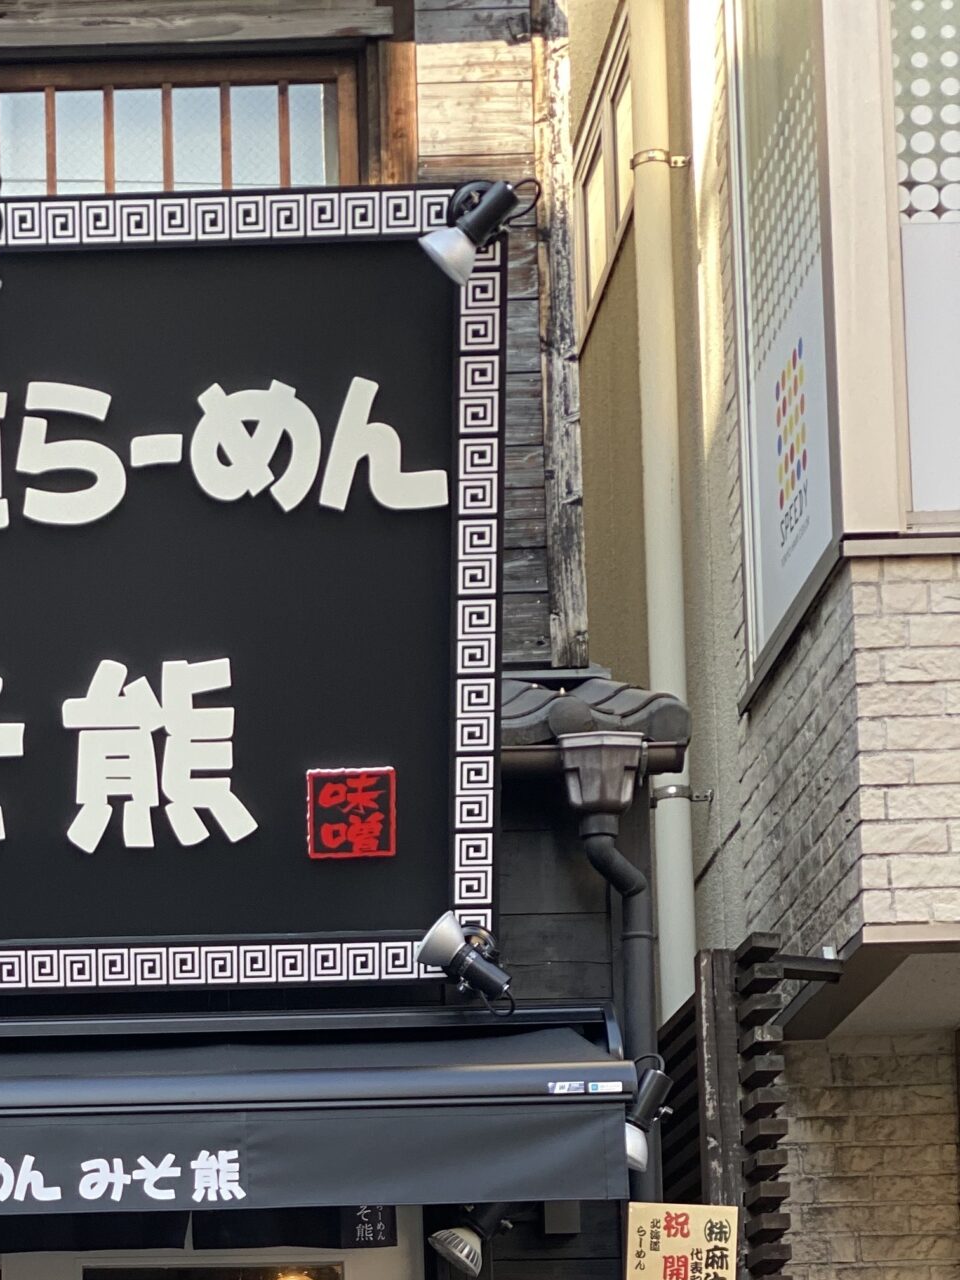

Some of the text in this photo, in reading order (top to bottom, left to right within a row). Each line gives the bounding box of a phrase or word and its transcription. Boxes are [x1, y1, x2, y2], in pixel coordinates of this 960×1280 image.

[781, 479, 808, 547] SPEEDY
[79, 1150, 246, 1202] みそ熊
[635, 1226, 646, 1271] らーめん
[663, 1211, 690, 1239] 祝
